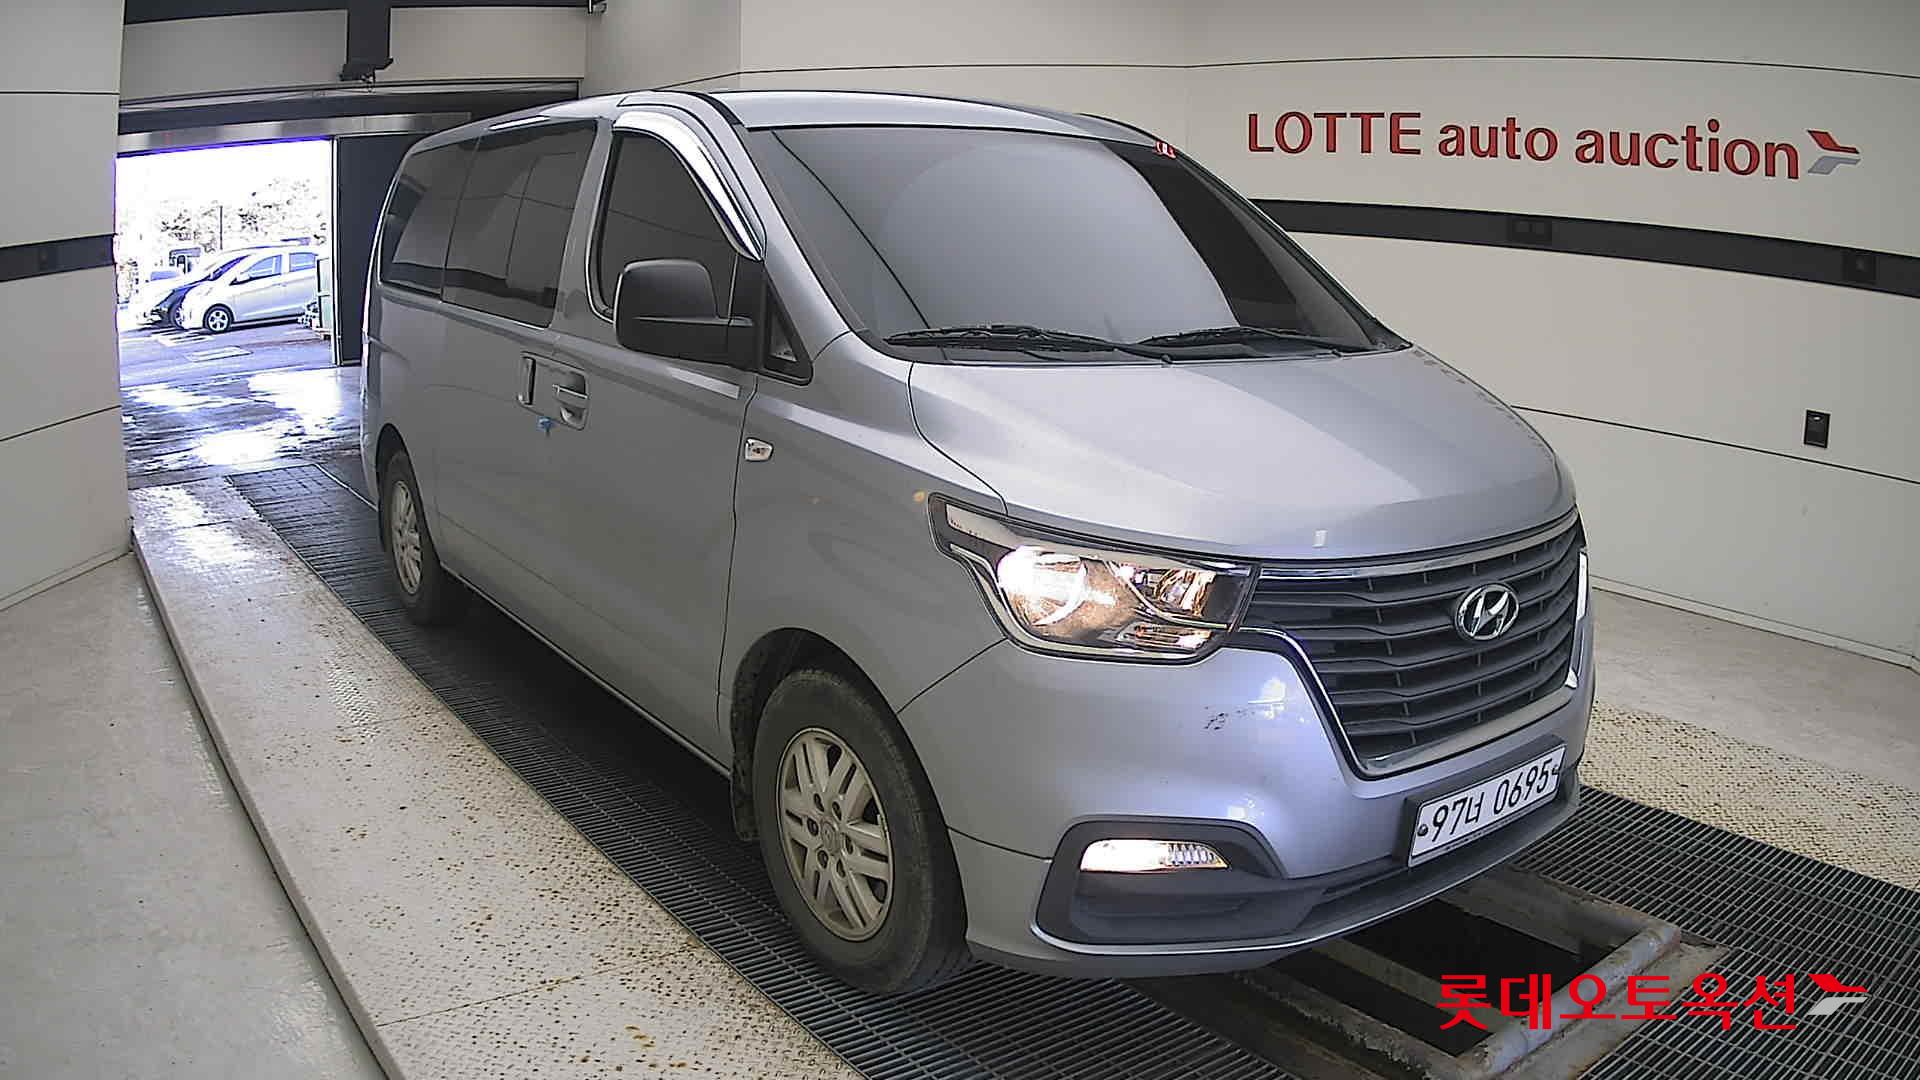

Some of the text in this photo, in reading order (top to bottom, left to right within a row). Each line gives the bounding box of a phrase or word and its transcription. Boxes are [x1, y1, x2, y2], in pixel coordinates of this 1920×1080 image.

[1247, 111, 1801, 180] LOTTE auto auction
[1431, 757, 1553, 843] 97너 0695
